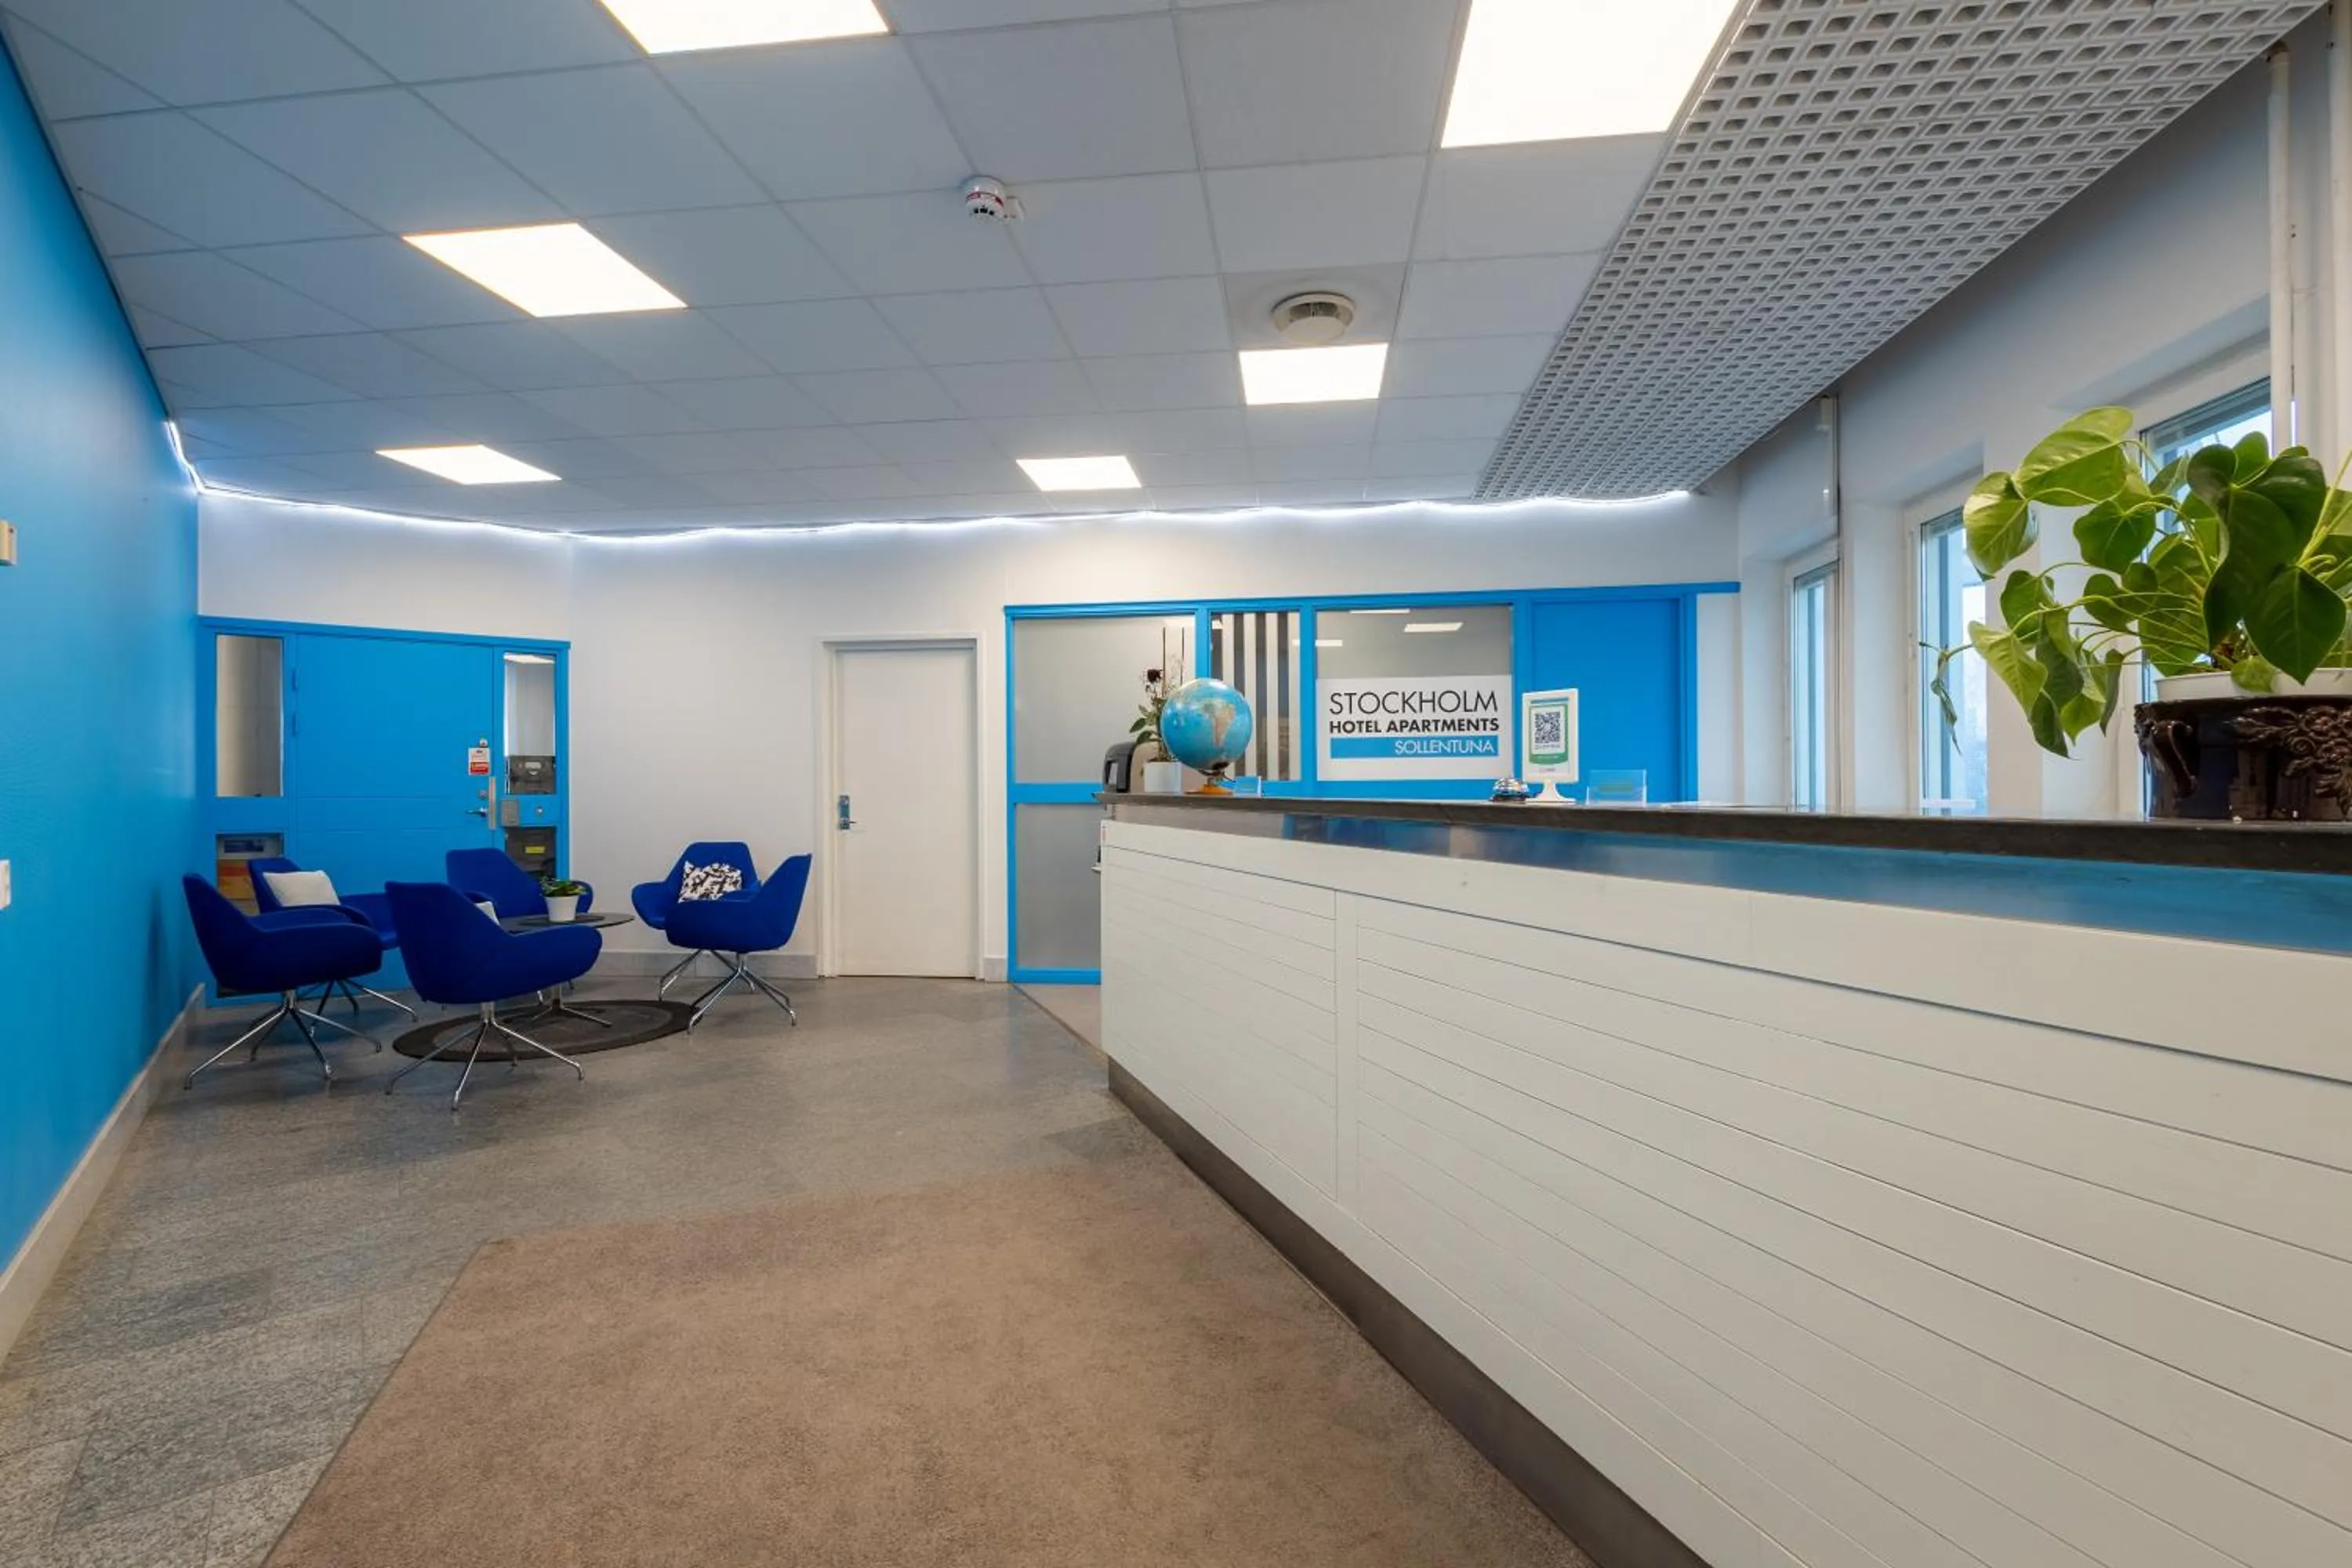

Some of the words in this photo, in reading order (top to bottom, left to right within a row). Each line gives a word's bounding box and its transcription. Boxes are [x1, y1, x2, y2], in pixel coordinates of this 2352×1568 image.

[1330, 691, 1498, 715] STOCKHOLM
[1330, 720, 1381, 734] HOTEL
[1386, 717, 1499, 733] APARTMENTS
[1395, 739, 1494, 755] SOLLENTUNA
